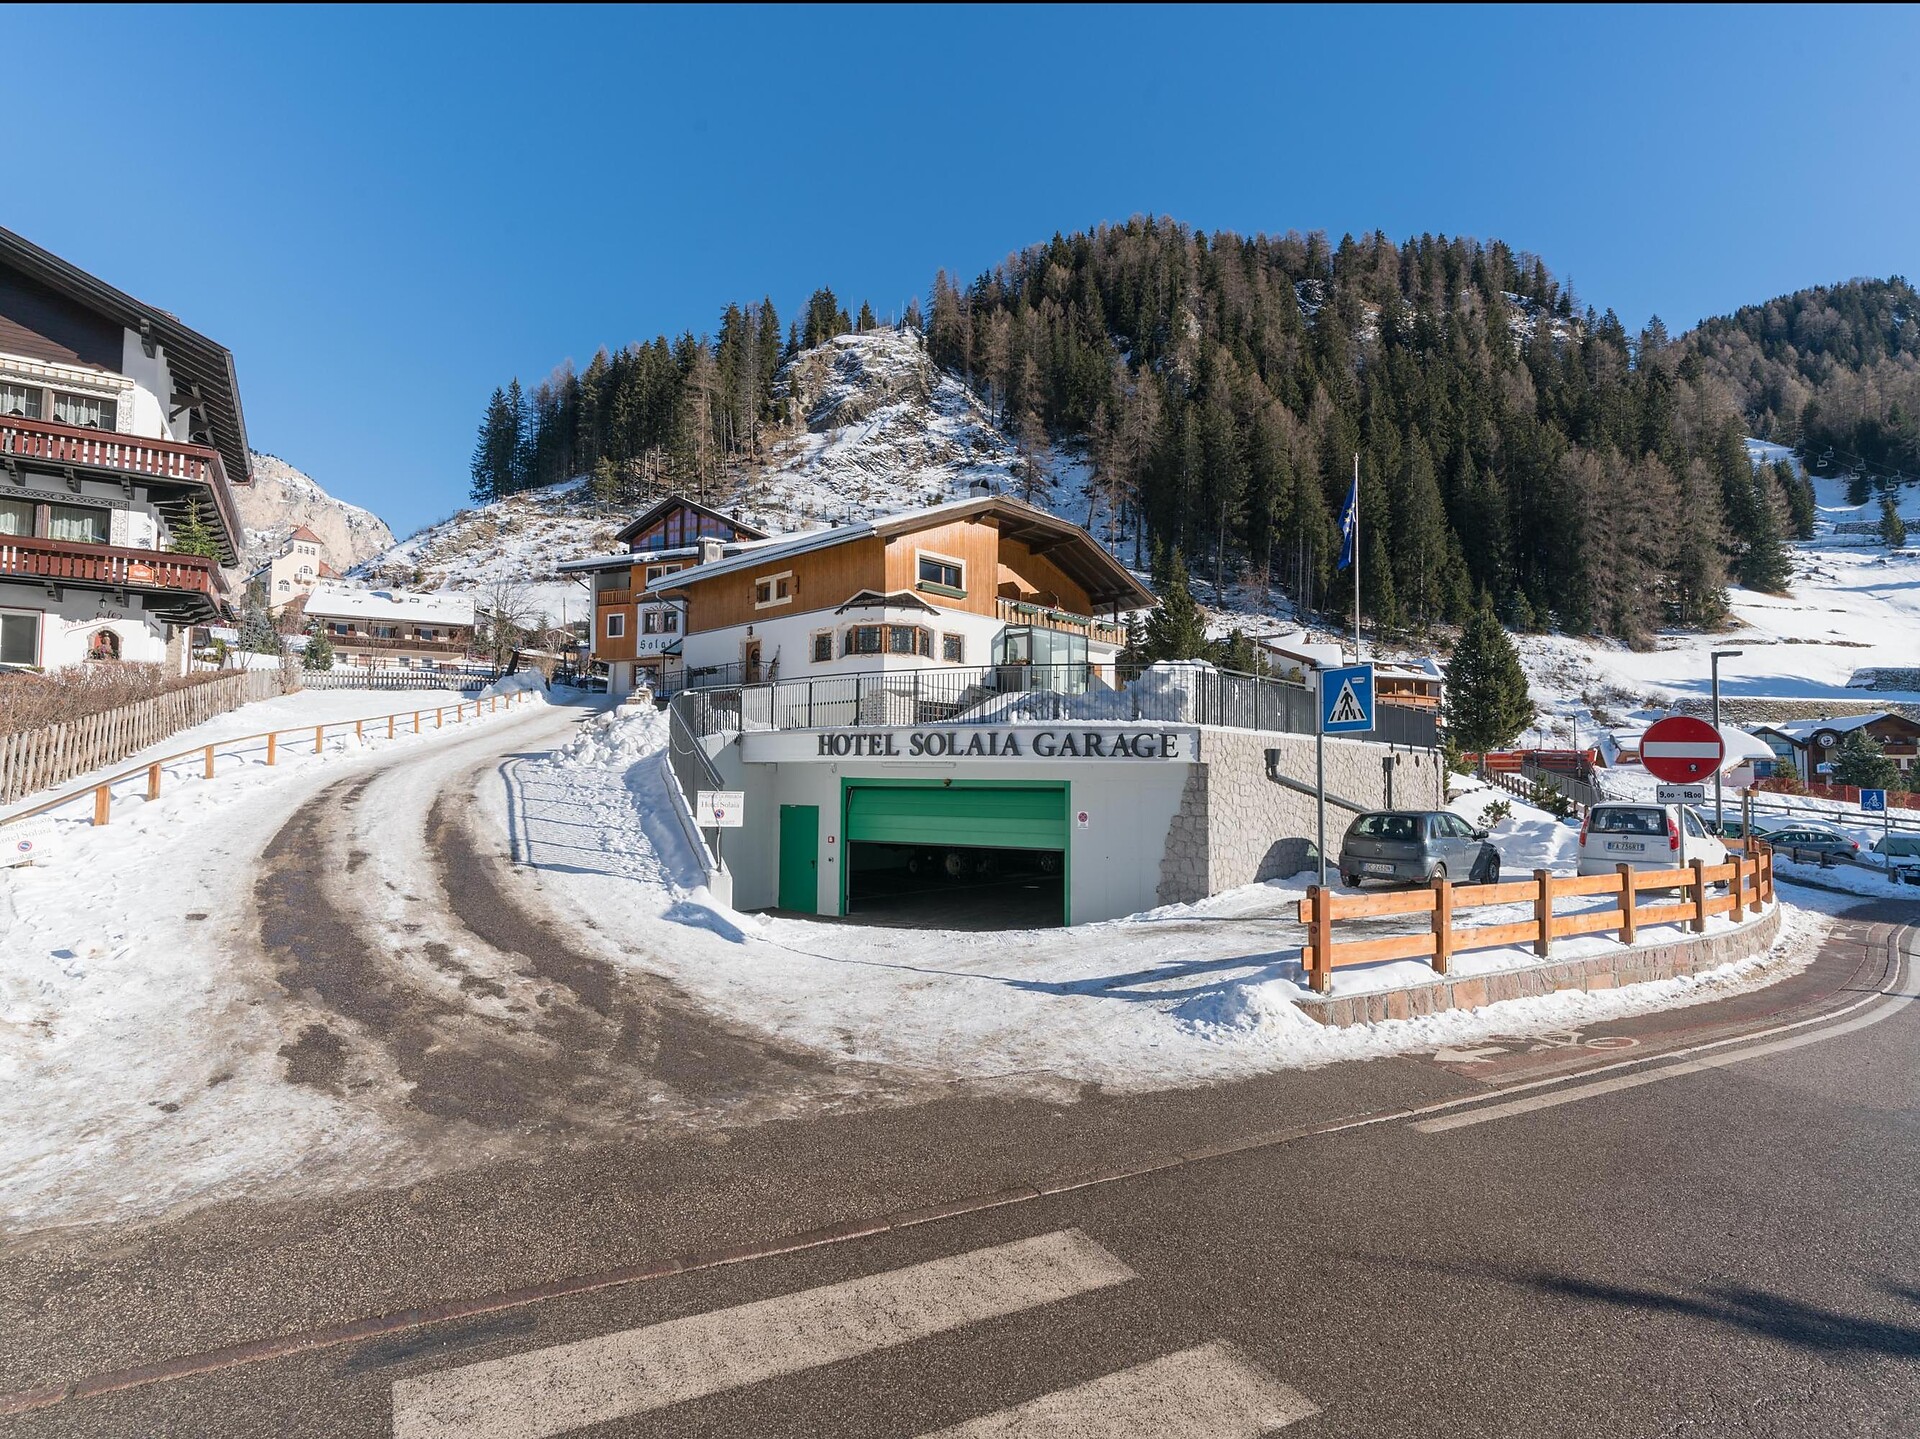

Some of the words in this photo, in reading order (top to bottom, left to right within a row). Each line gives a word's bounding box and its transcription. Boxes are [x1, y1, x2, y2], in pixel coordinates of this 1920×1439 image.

[817, 733, 899, 757] HOTEL
[909, 732, 1022, 757] SOLAIA
[1032, 732, 1179, 758] GARAGE
[1659, 791, 1675, 799] 9.00
